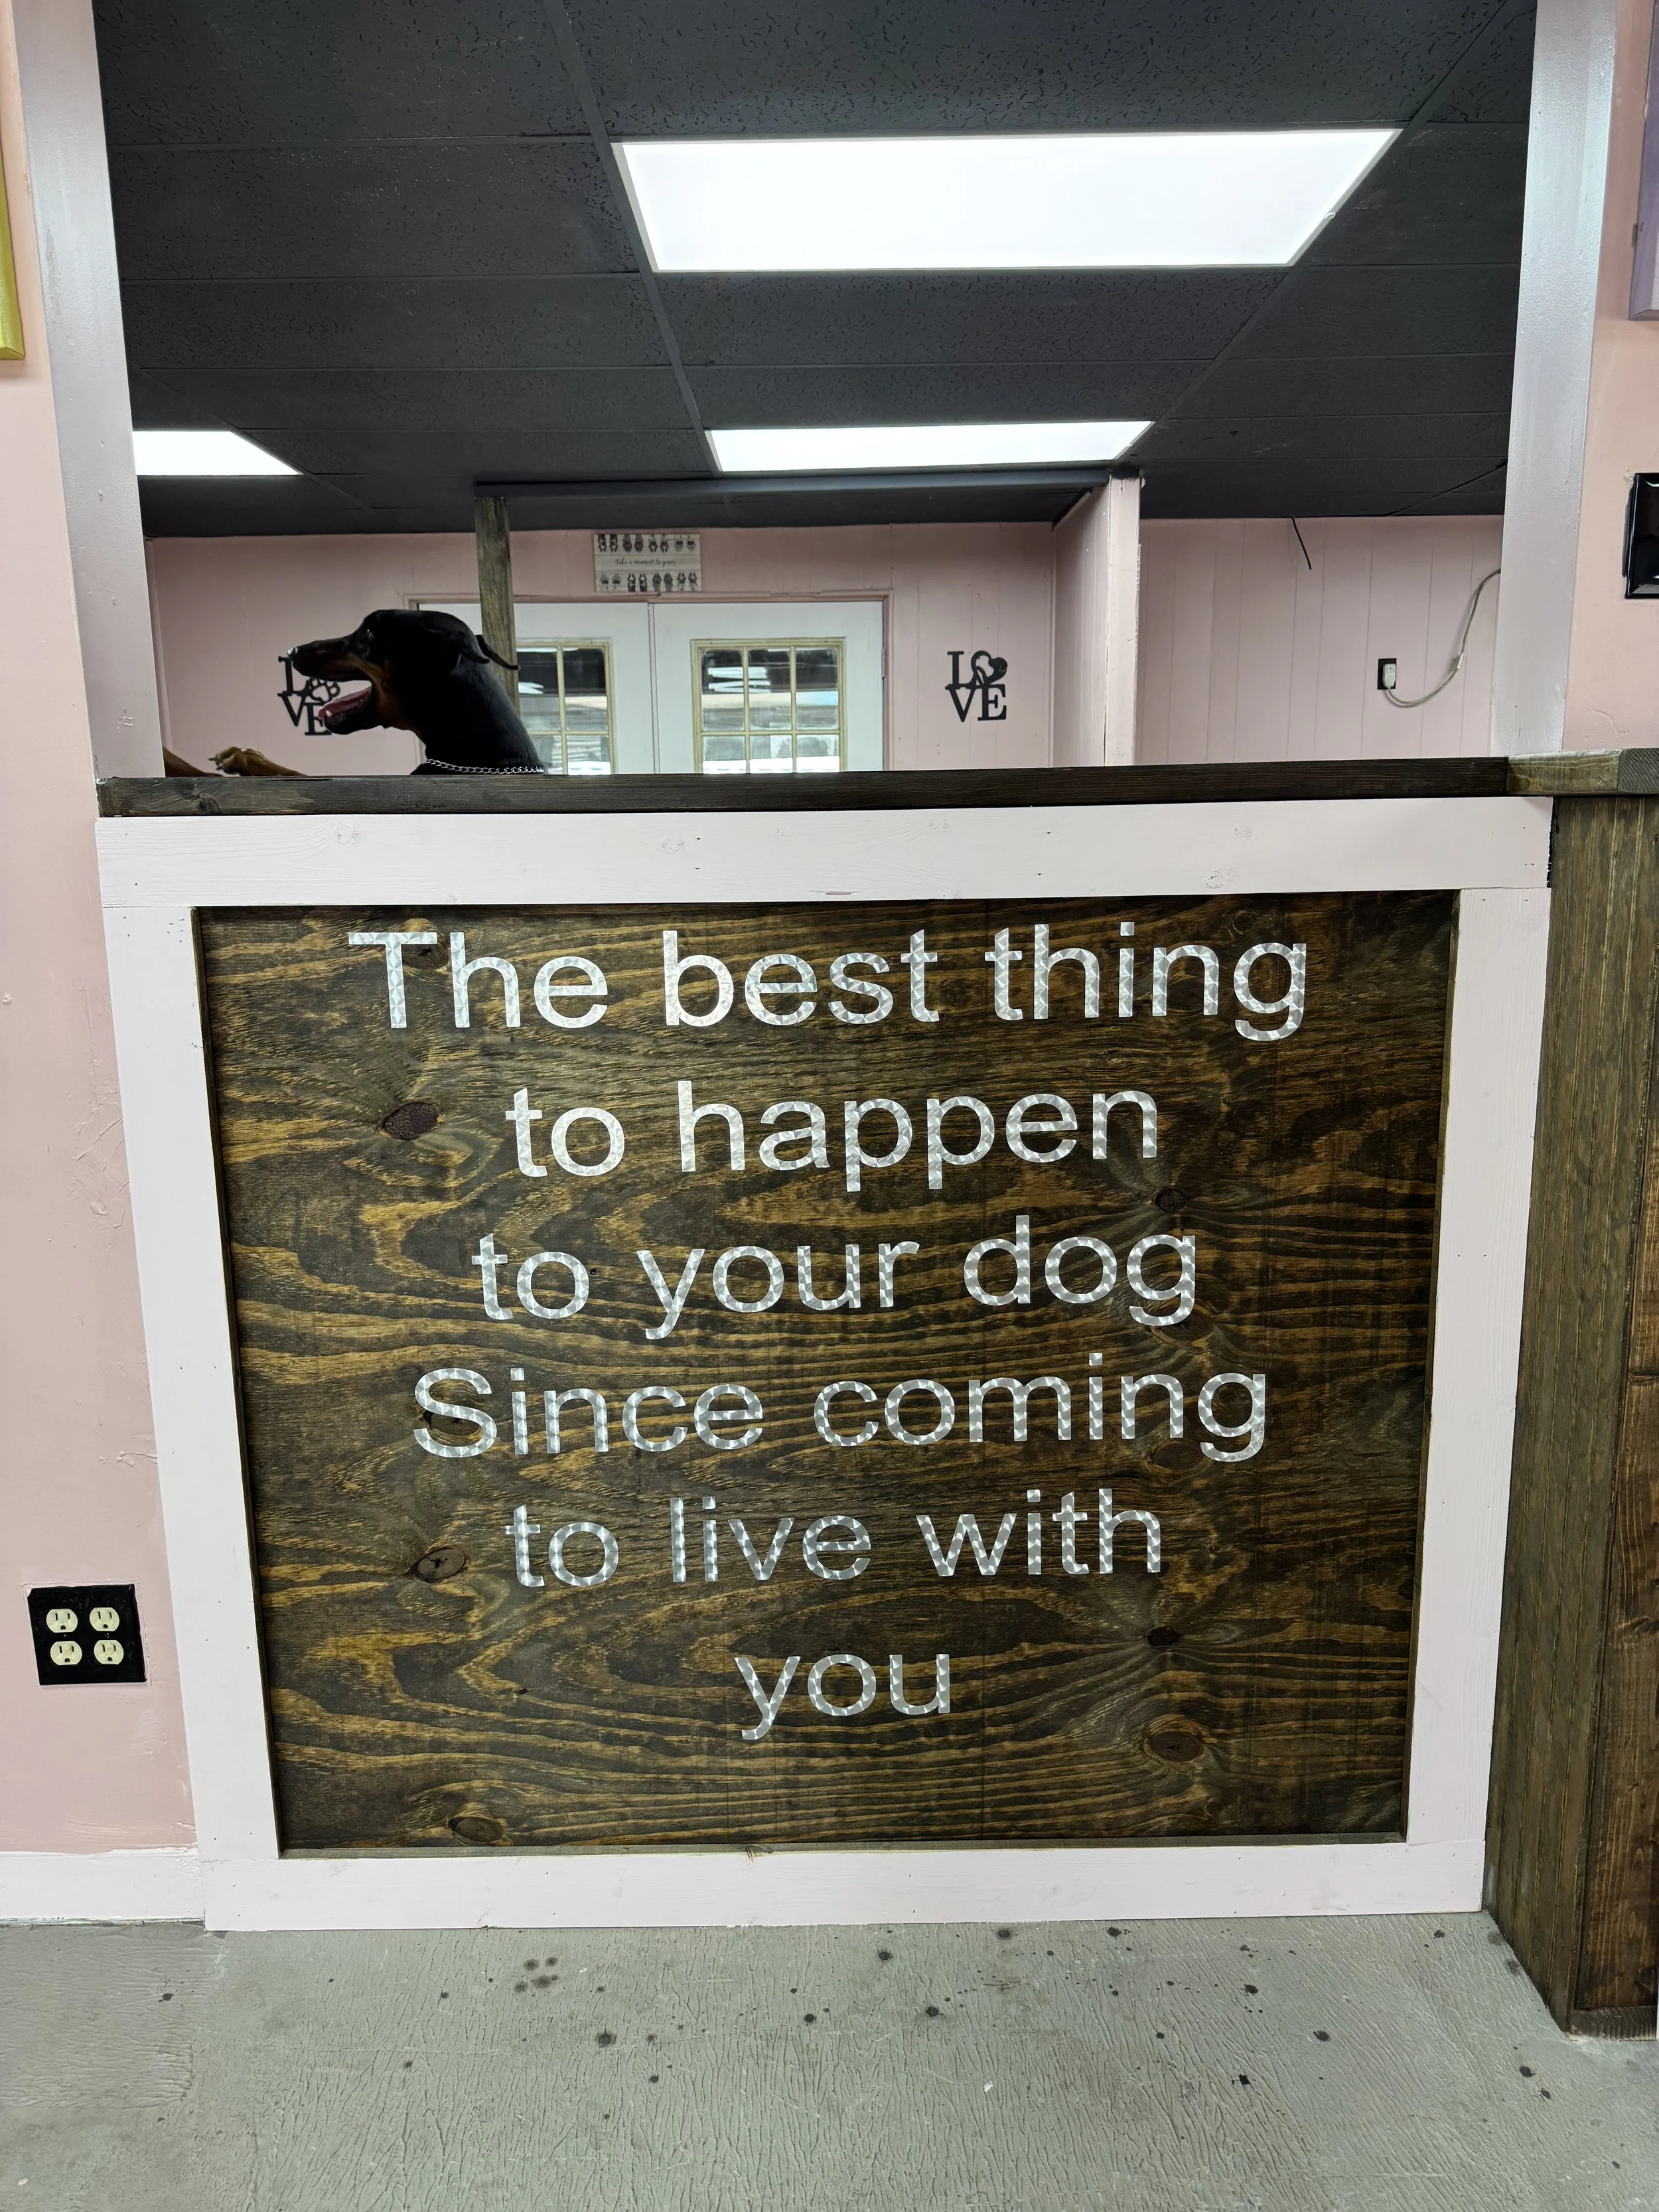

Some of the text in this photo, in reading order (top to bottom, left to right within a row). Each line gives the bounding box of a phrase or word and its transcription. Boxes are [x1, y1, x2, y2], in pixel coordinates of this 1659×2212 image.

[348, 921, 1307, 1041] The best thing
[505, 1080, 1158, 1193] to happen
[472, 1215, 1196, 1340] to your dog
[413, 1353, 1265, 1462] Since coming
[505, 1488, 1161, 1587] to live with
[735, 1653, 950, 1740] you
